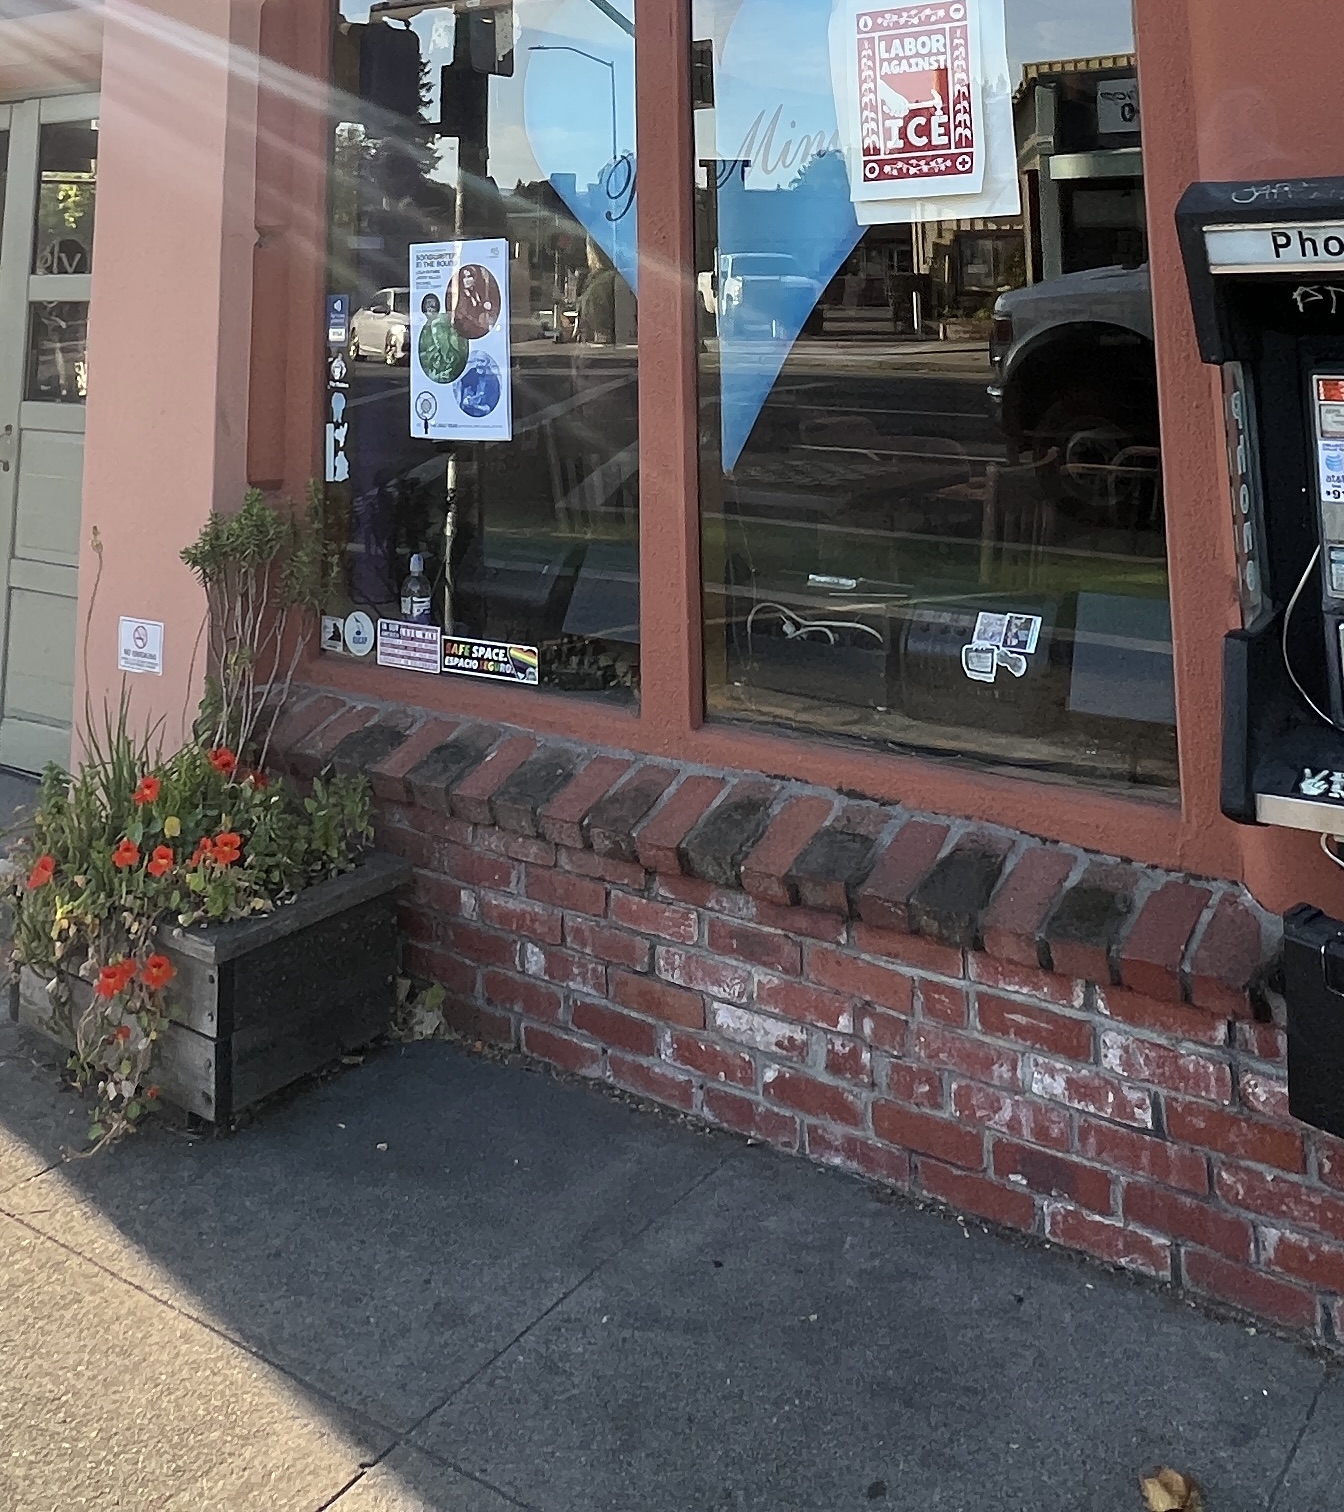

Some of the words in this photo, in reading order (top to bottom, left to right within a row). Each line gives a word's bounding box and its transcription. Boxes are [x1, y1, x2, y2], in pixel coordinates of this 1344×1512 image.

[879, 34, 946, 59] LABOR
[881, 55, 947, 75] AGAINST
[884, 115, 949, 149] ICE
[445, 642, 471, 656] SAFE
[472, 645, 508, 661] SPACE.
[445, 656, 478, 670] ESPACIO
